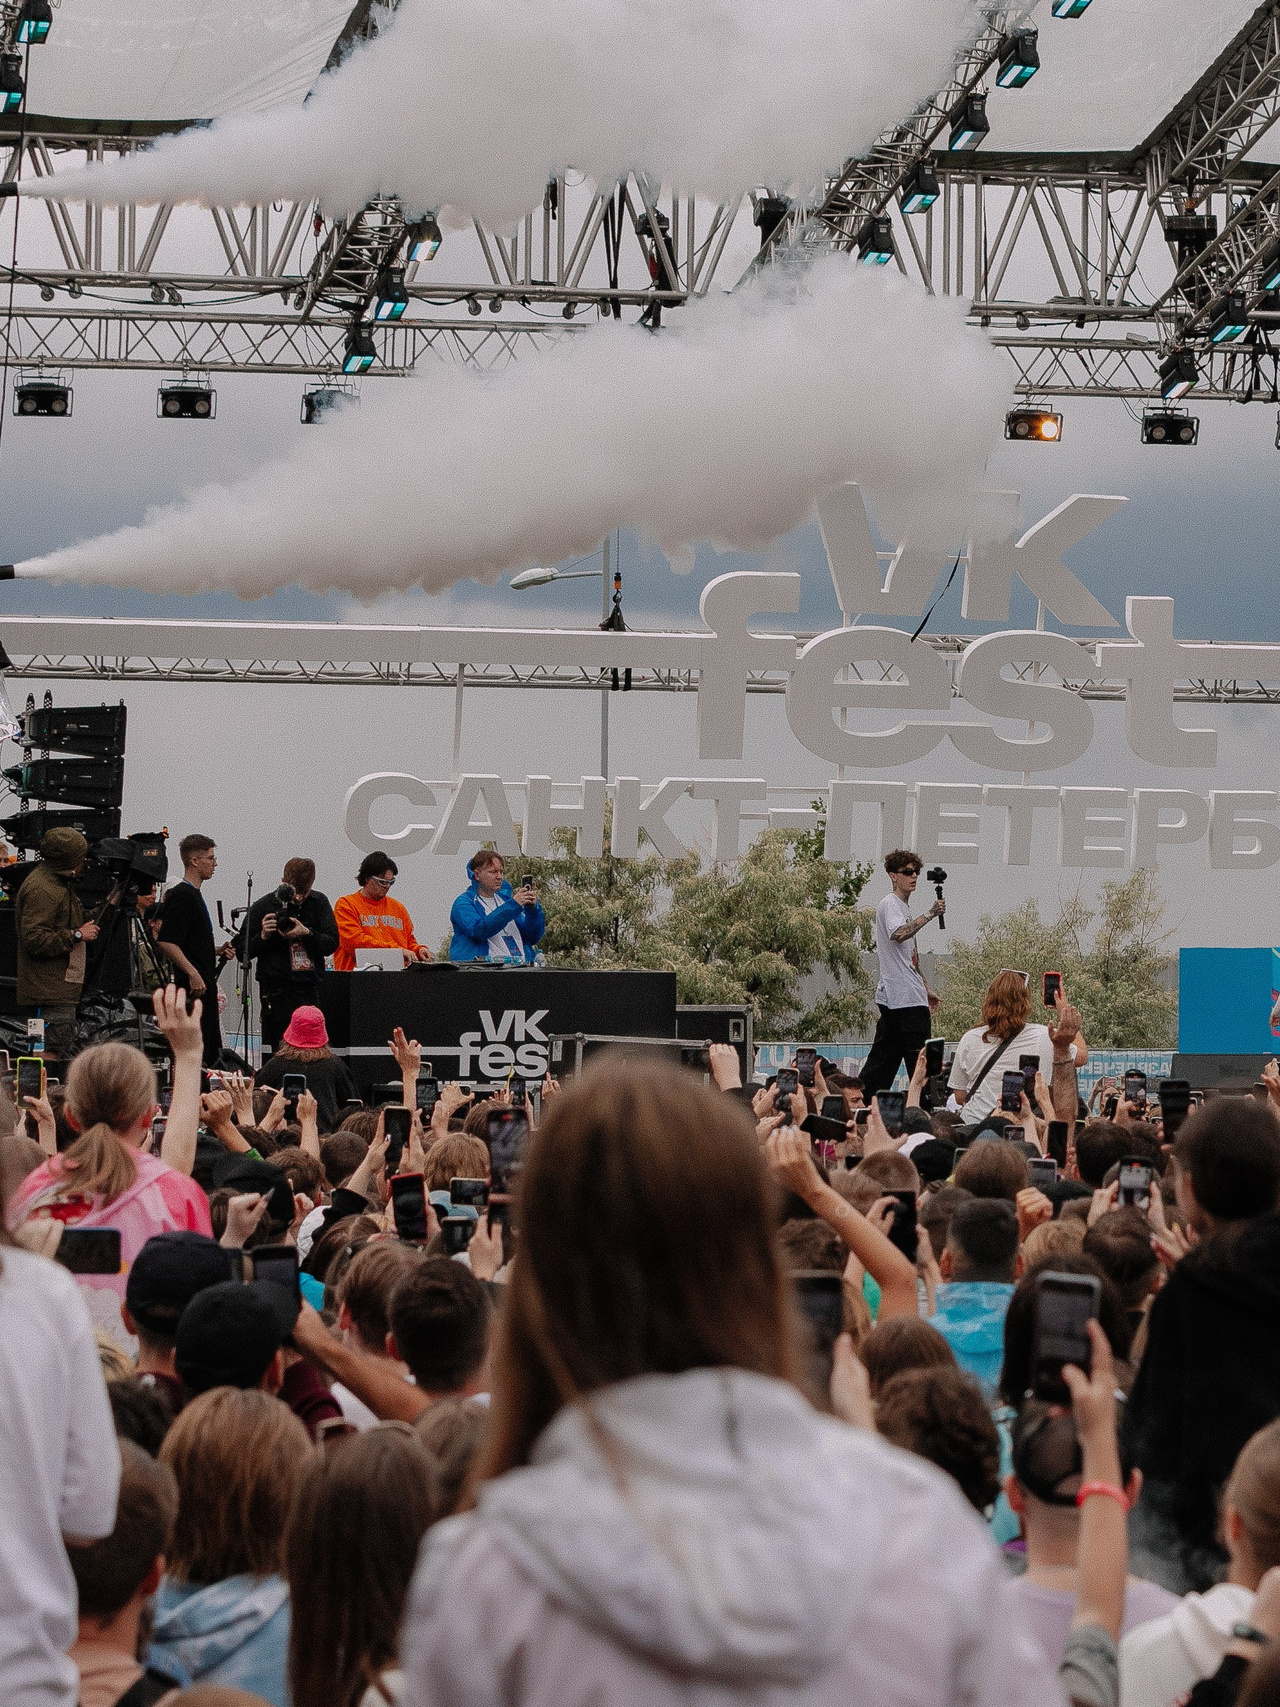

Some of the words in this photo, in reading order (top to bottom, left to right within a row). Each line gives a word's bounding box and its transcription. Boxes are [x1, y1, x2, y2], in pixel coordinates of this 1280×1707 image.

[815, 481, 1130, 628] VK
[697, 570, 1218, 772] fest
[458, 1032, 549, 1078] fes
[478, 1010, 550, 1042] VK
